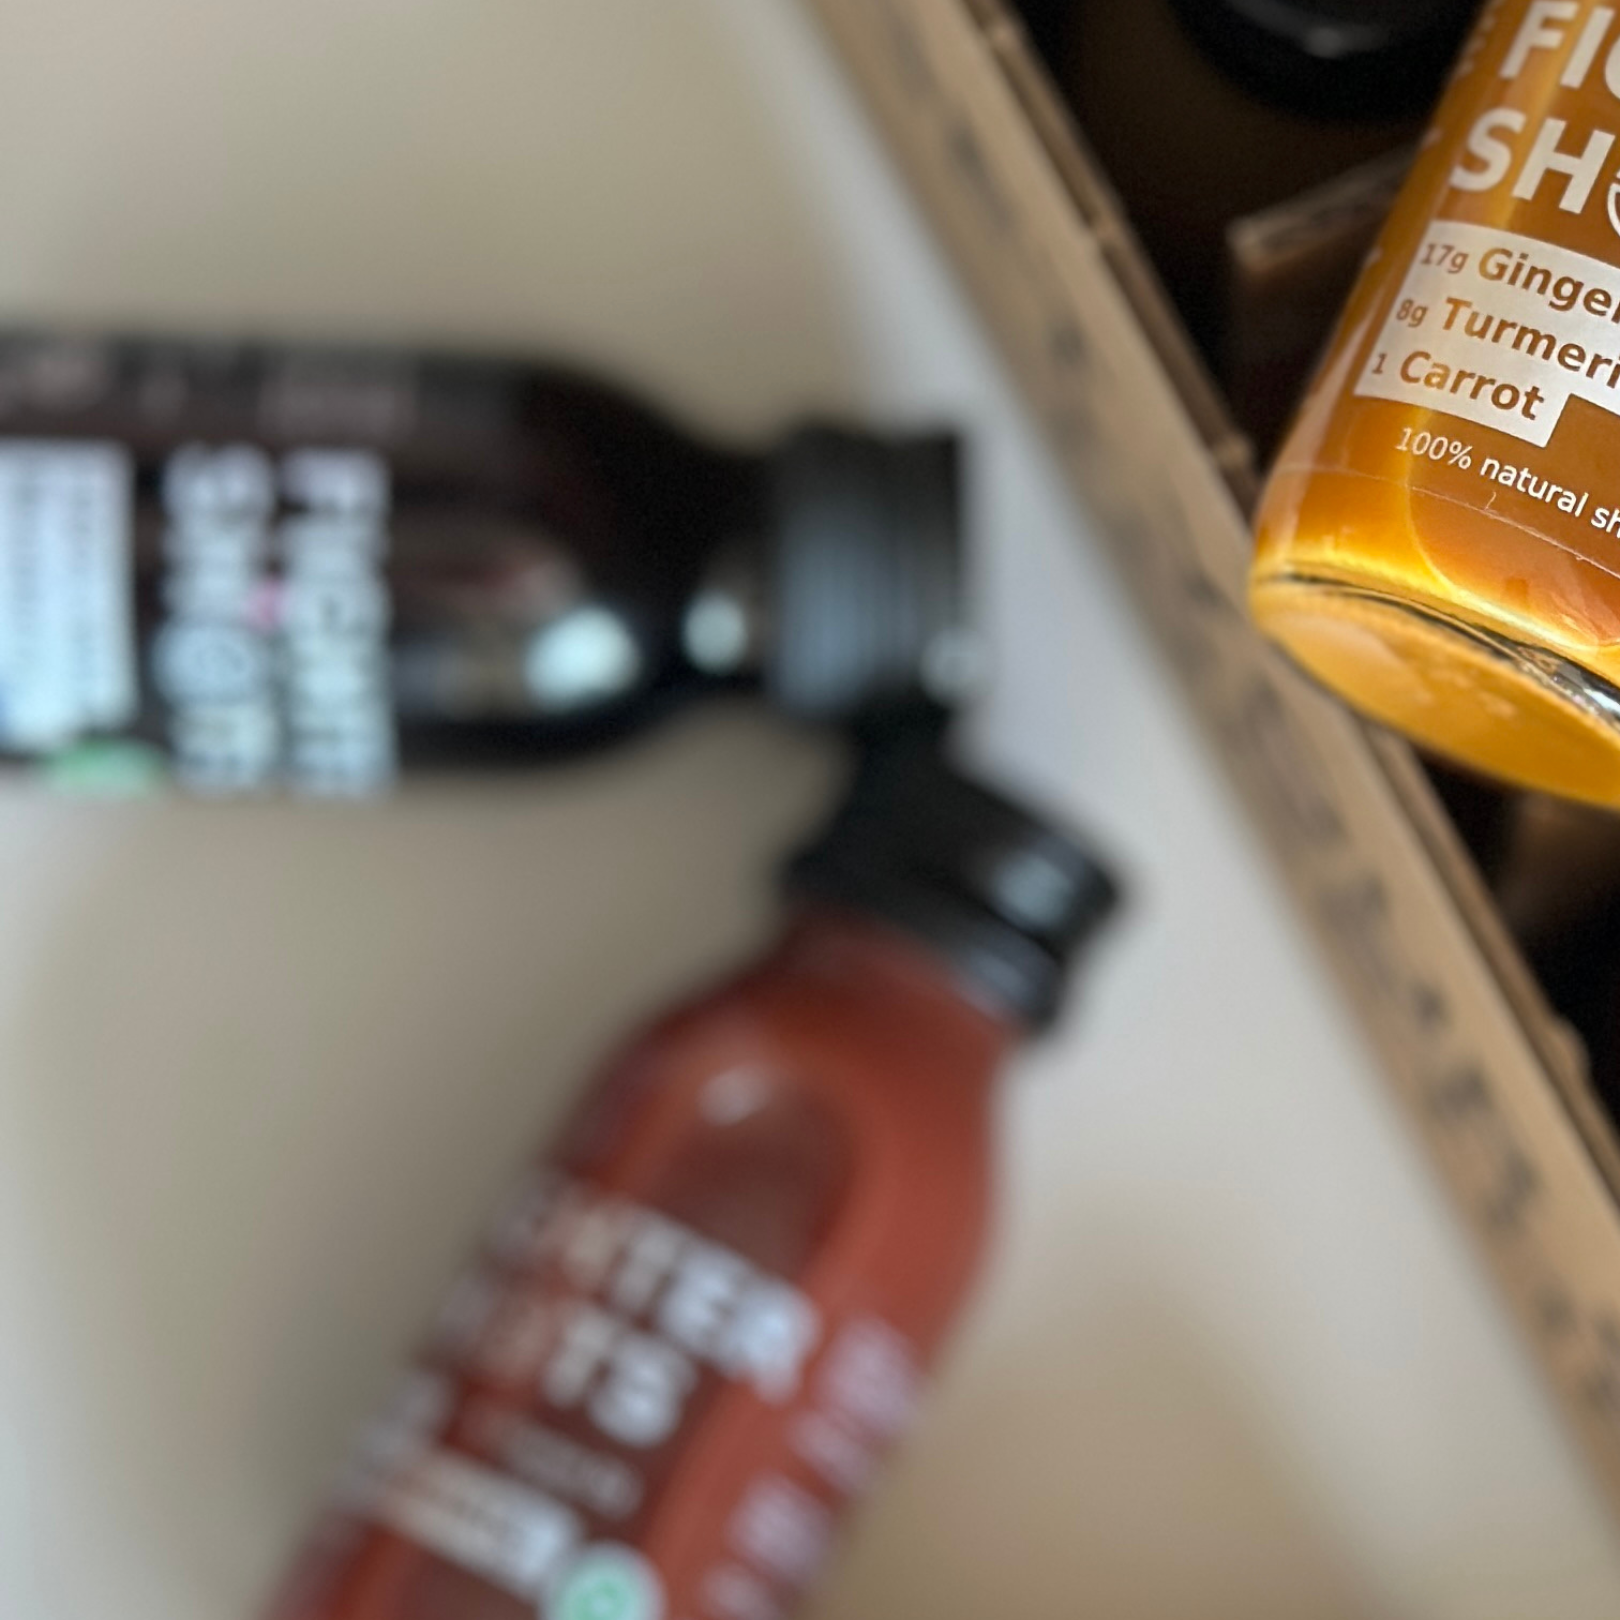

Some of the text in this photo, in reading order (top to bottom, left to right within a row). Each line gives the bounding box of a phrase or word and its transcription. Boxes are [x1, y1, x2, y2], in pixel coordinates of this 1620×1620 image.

[1420, 243, 1469, 274] 17g
[1396, 299, 1429, 328] 8g
[1371, 350, 1546, 421] 1 Carrot
[1395, 427, 1473, 470] 100%
[1480, 456, 1589, 517] natural
